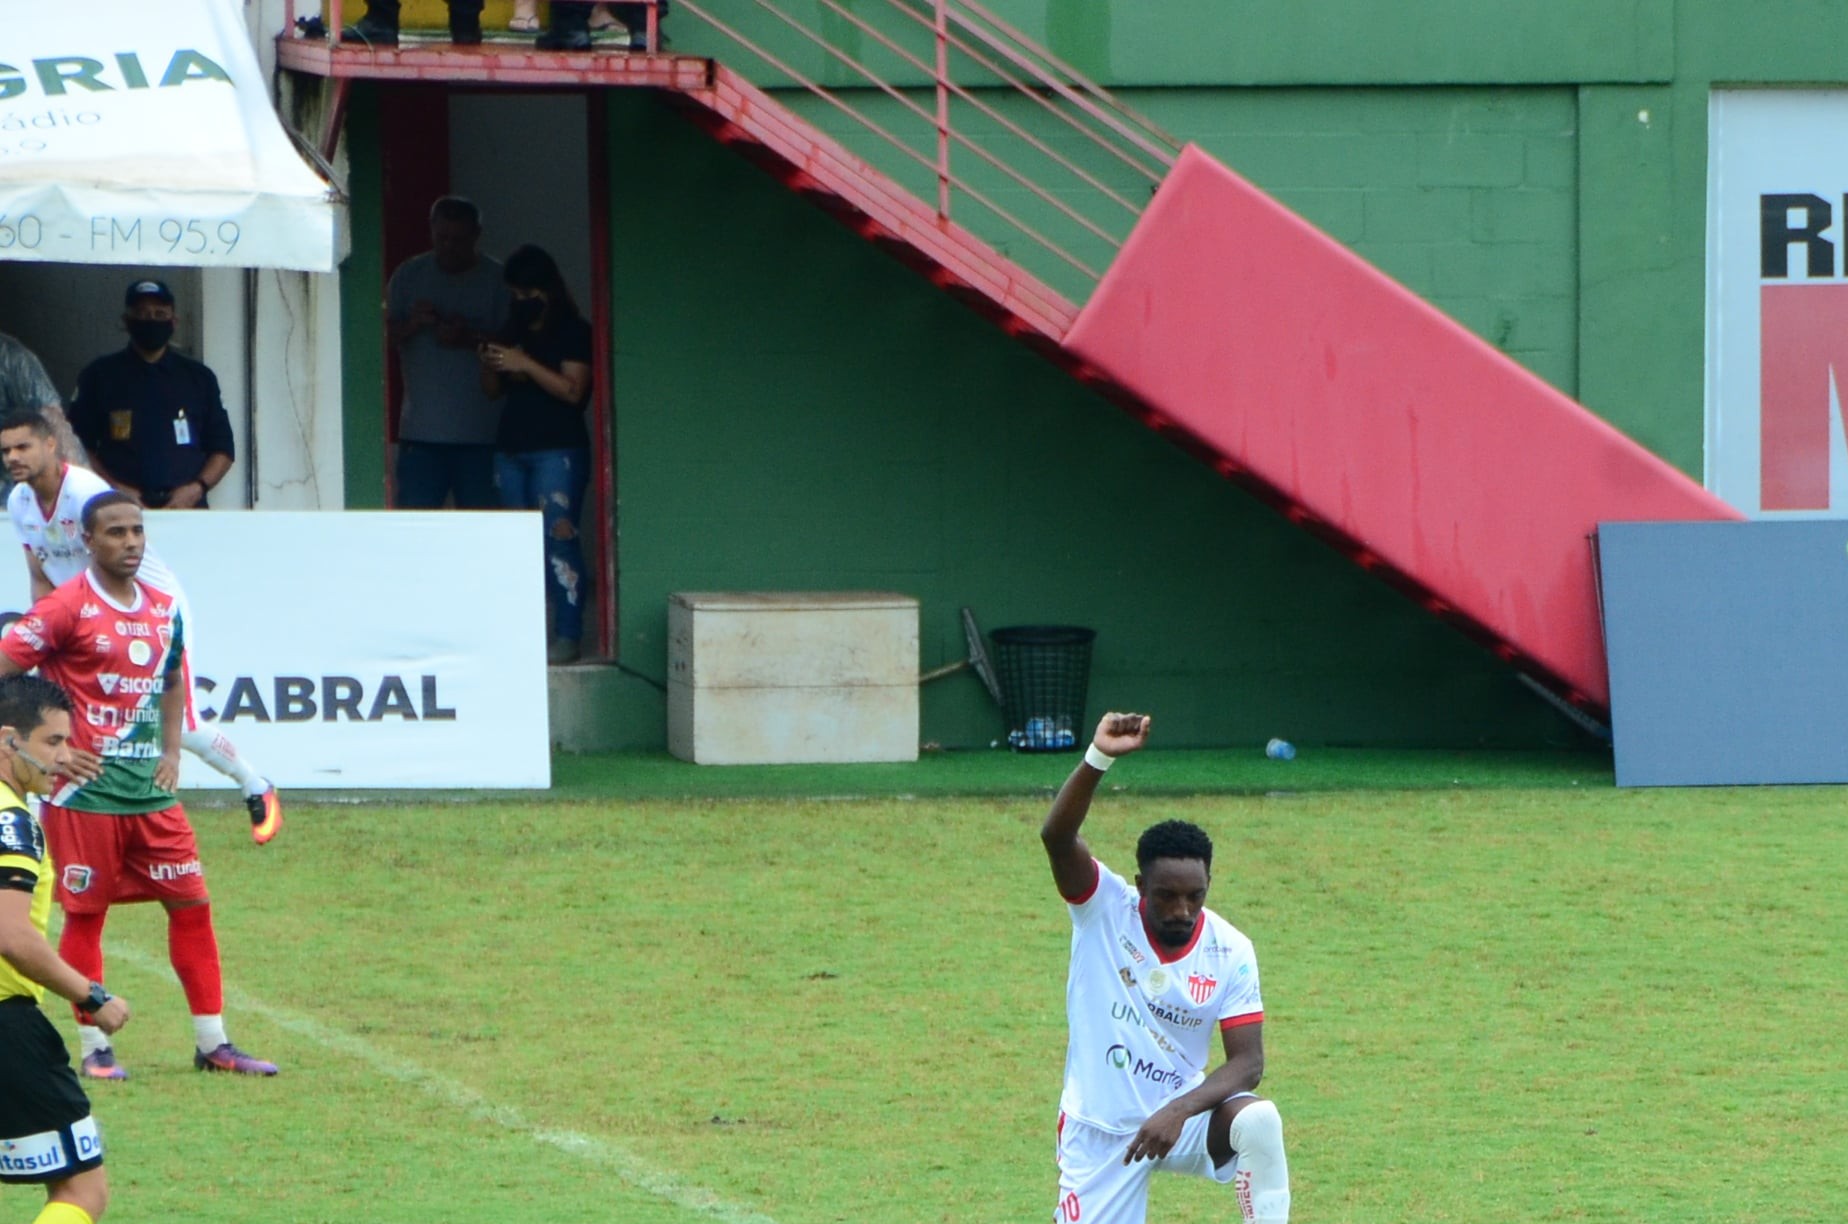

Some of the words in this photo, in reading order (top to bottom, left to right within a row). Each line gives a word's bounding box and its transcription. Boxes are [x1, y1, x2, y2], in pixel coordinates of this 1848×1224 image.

[90, 216, 141, 251] FM
[158, 217, 240, 255] 95.9
[119, 676, 165, 694] SICOO
[194, 675, 456, 722] CABRAL
[1060, 1191, 1081, 1224] 10
